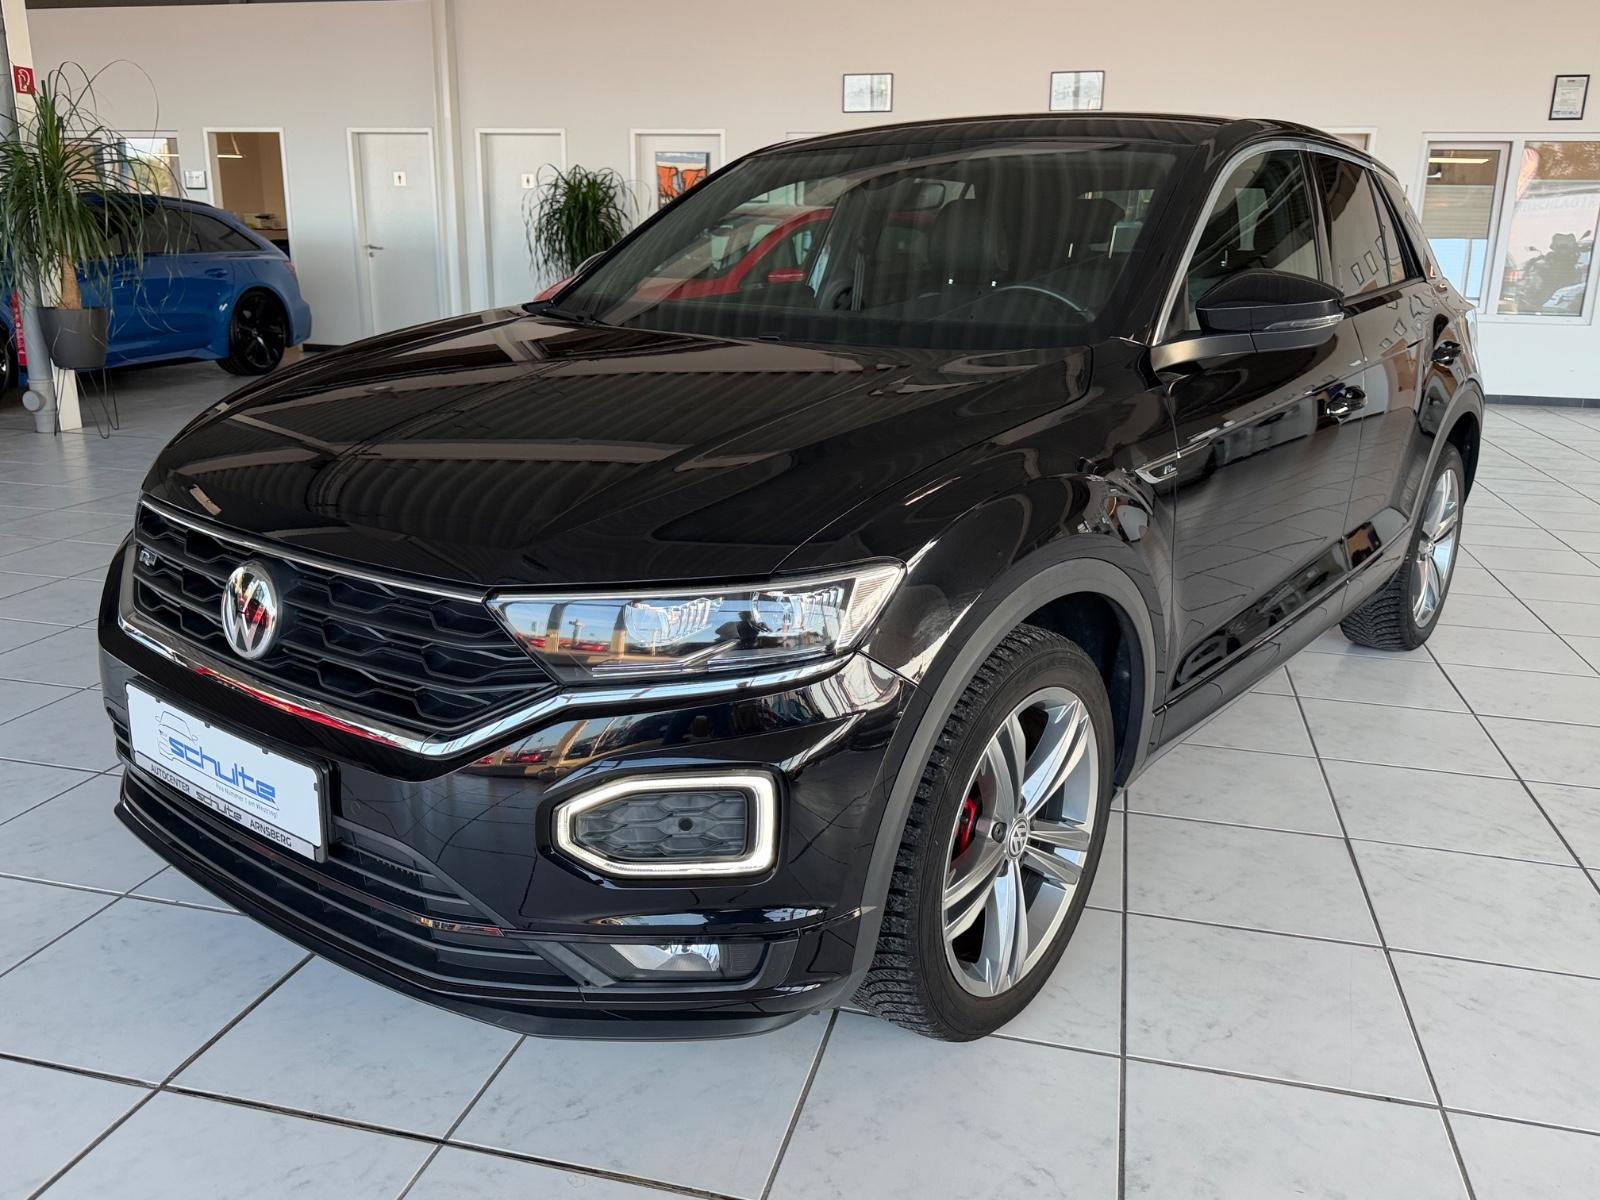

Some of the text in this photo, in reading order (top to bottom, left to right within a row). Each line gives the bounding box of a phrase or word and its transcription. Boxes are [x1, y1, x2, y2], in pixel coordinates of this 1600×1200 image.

[150, 764, 191, 794] AUTOCENTER
[195, 790, 242, 821] schulte
[250, 819, 292, 847] ARNSBERG
[168, 736, 276, 802] schulte
